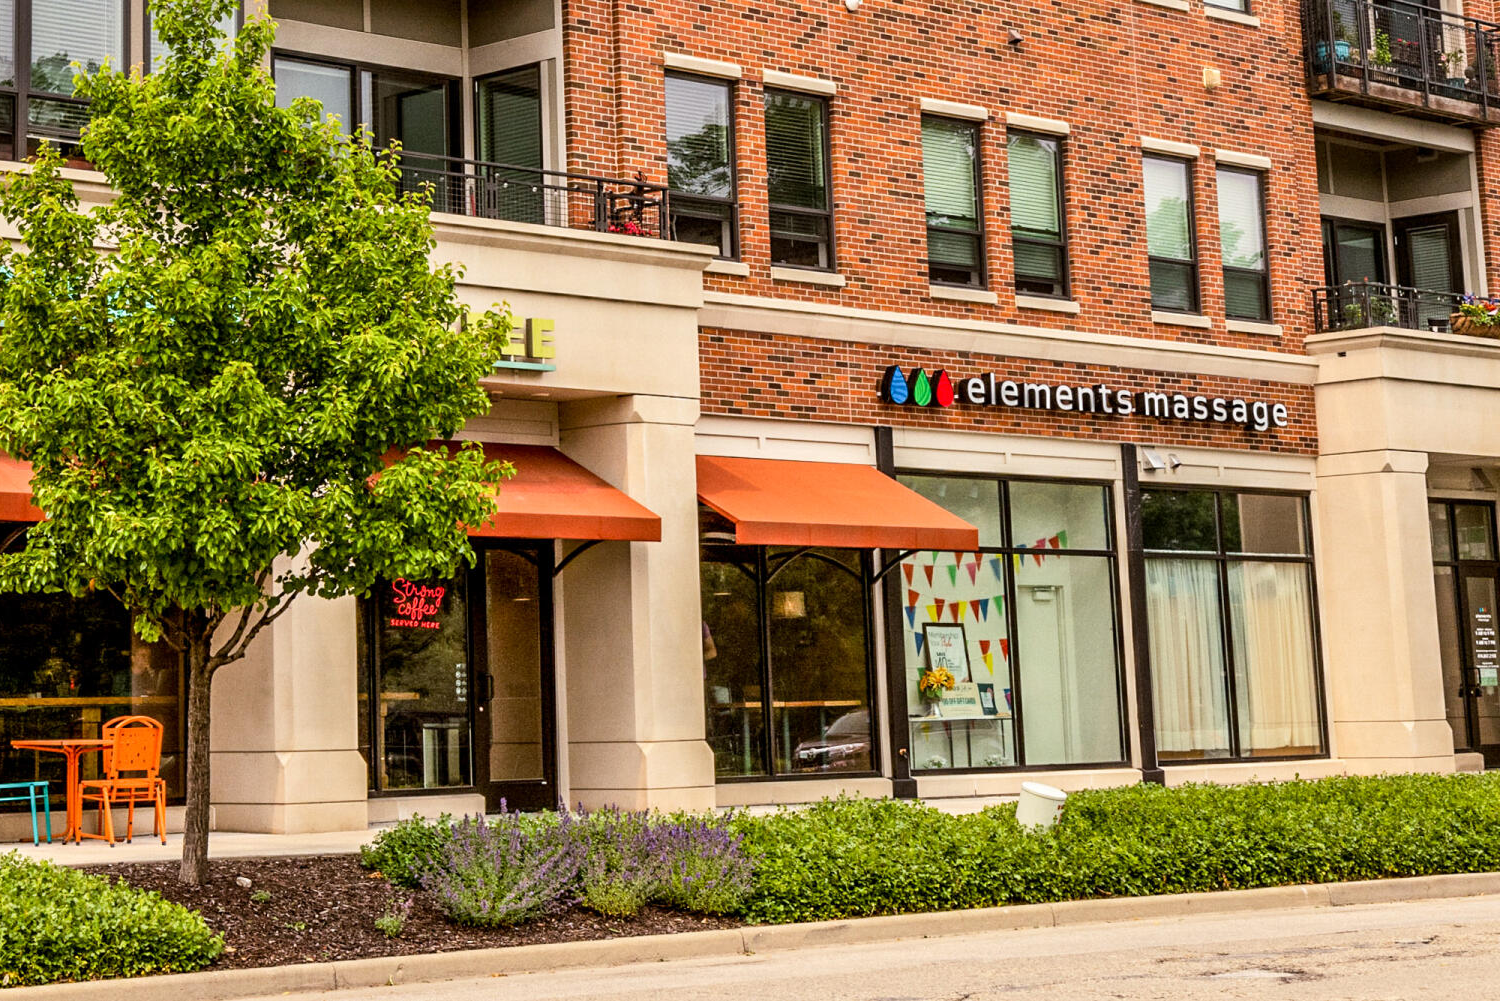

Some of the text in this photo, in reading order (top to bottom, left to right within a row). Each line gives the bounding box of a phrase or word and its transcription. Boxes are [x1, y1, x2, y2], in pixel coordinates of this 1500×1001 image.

[967, 372, 1288, 431] elements massage
[392, 577, 444, 607] Strong
[397, 597, 437, 620] coffee
[390, 619, 440, 629] SERVED HERE
